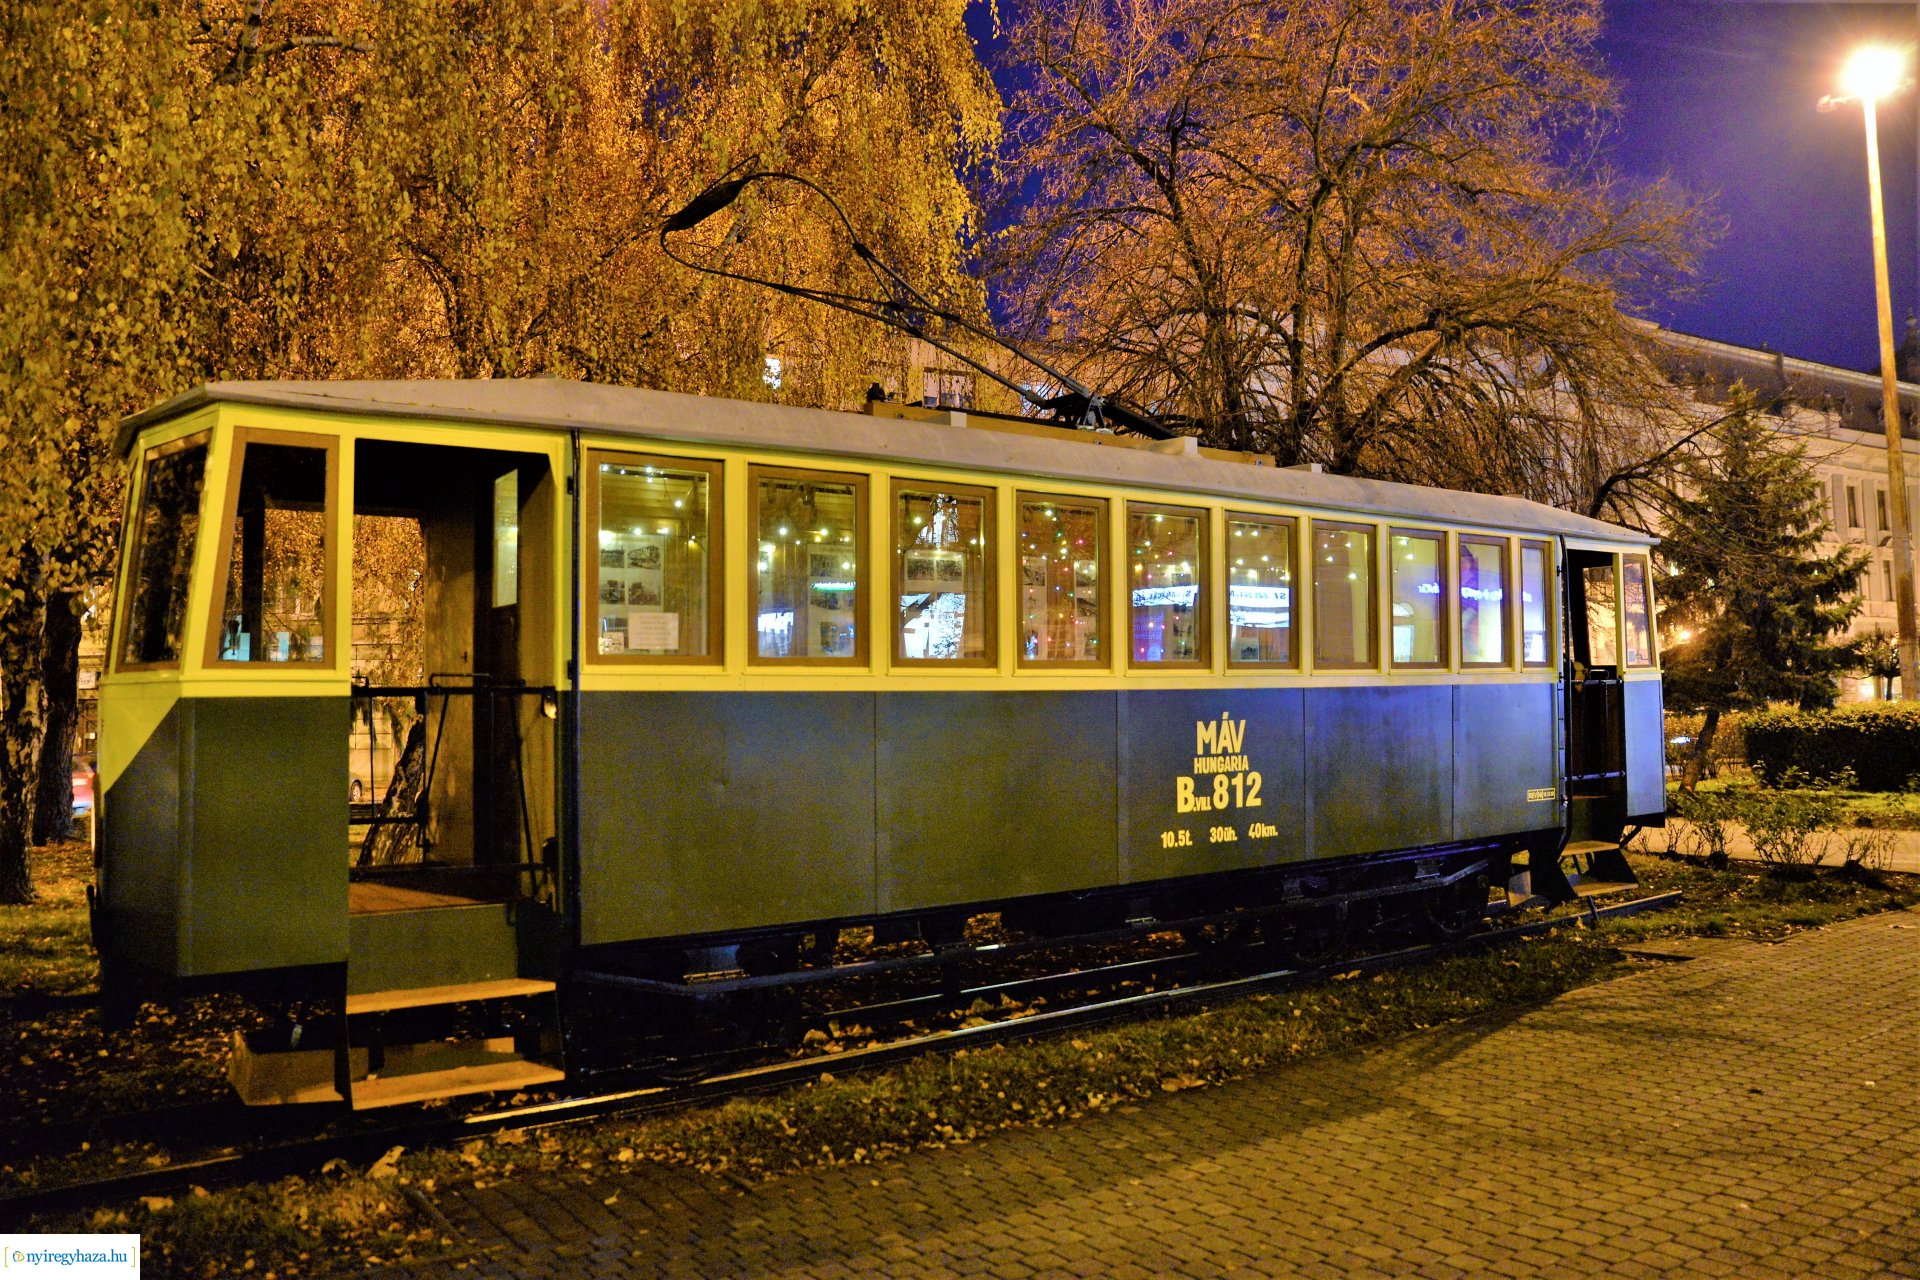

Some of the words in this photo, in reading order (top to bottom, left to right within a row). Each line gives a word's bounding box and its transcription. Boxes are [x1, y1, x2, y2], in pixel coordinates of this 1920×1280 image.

[1196, 712, 1246, 755] MÁV
[1194, 755, 1249, 774] HUNGARIA
[1161, 829, 1193, 849] 10.5t.
[1248, 822, 1279, 839] 40km.
